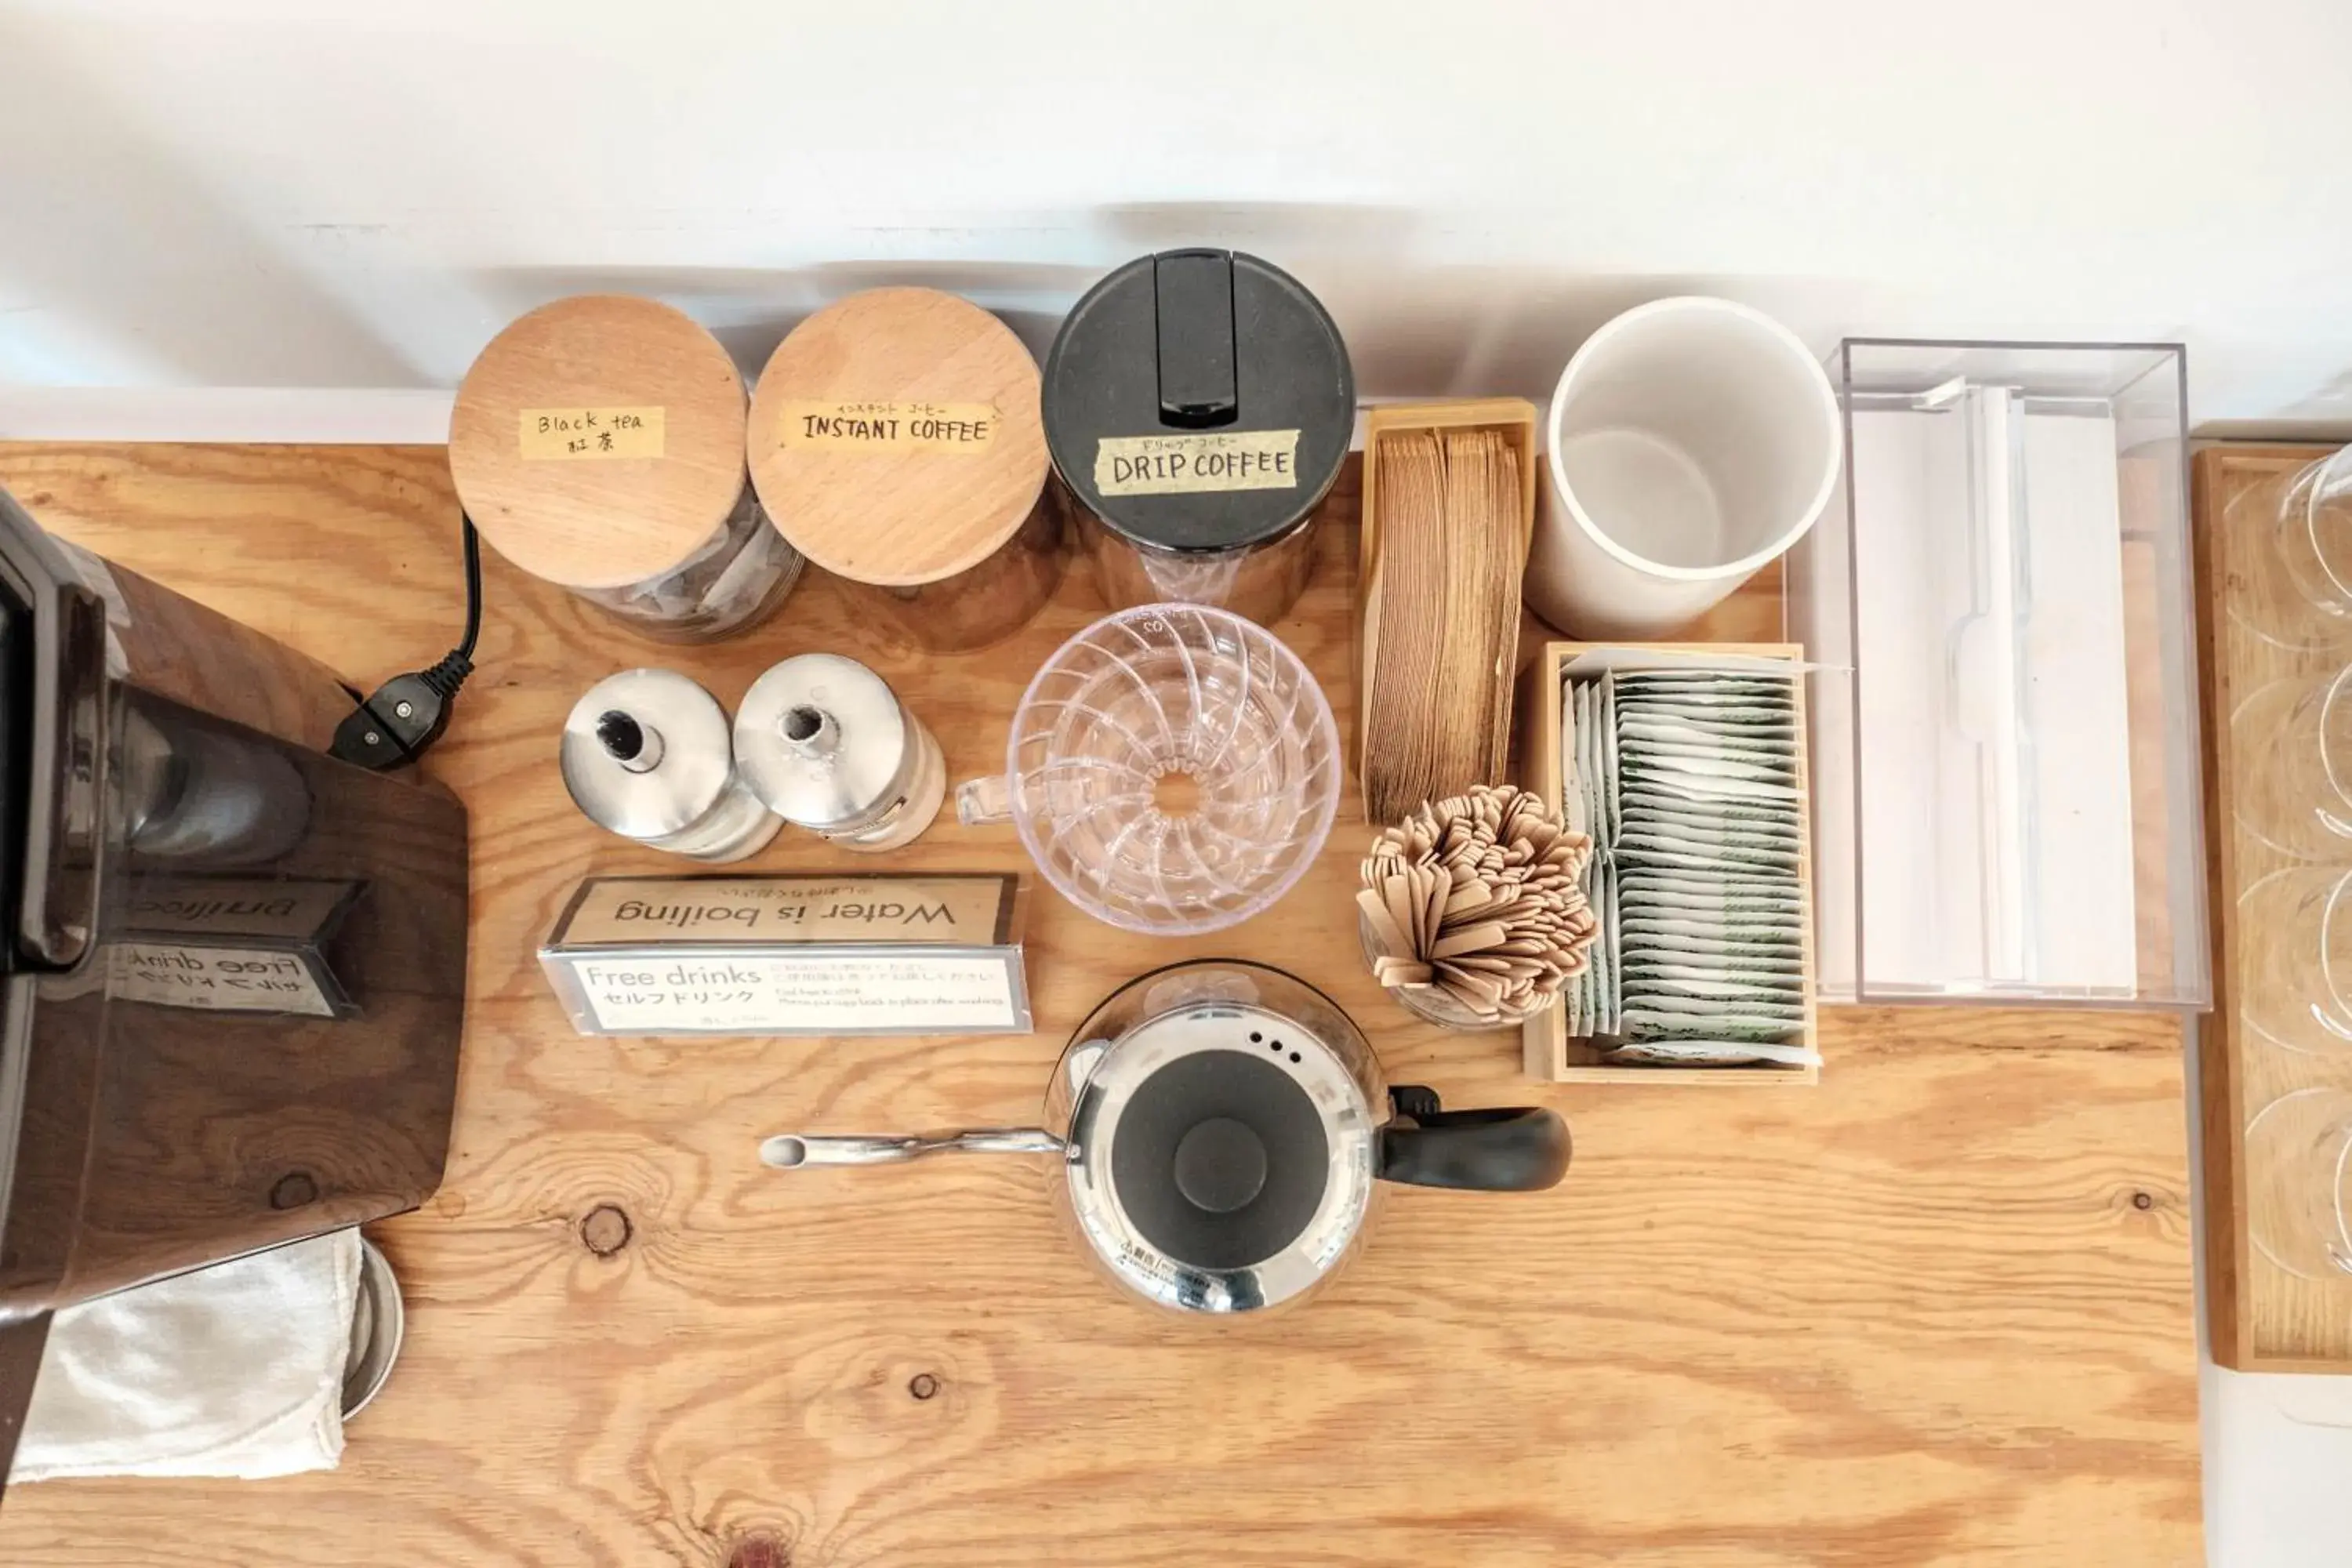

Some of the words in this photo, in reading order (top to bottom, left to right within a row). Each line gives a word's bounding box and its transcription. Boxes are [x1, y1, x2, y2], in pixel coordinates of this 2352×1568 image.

[539, 410, 597, 434] Black
[611, 415, 644, 430] tea
[802, 414, 900, 441] INSTANT
[909, 419, 989, 441] COFFEE
[1113, 454, 1186, 483] DRIP
[1194, 451, 1290, 477] COFFEE
[615, 900, 760, 928] boiling
[776, 905, 807, 925] is
[821, 902, 956, 926] Water
[586, 966, 655, 986] Free
[666, 964, 763, 985] drinks
